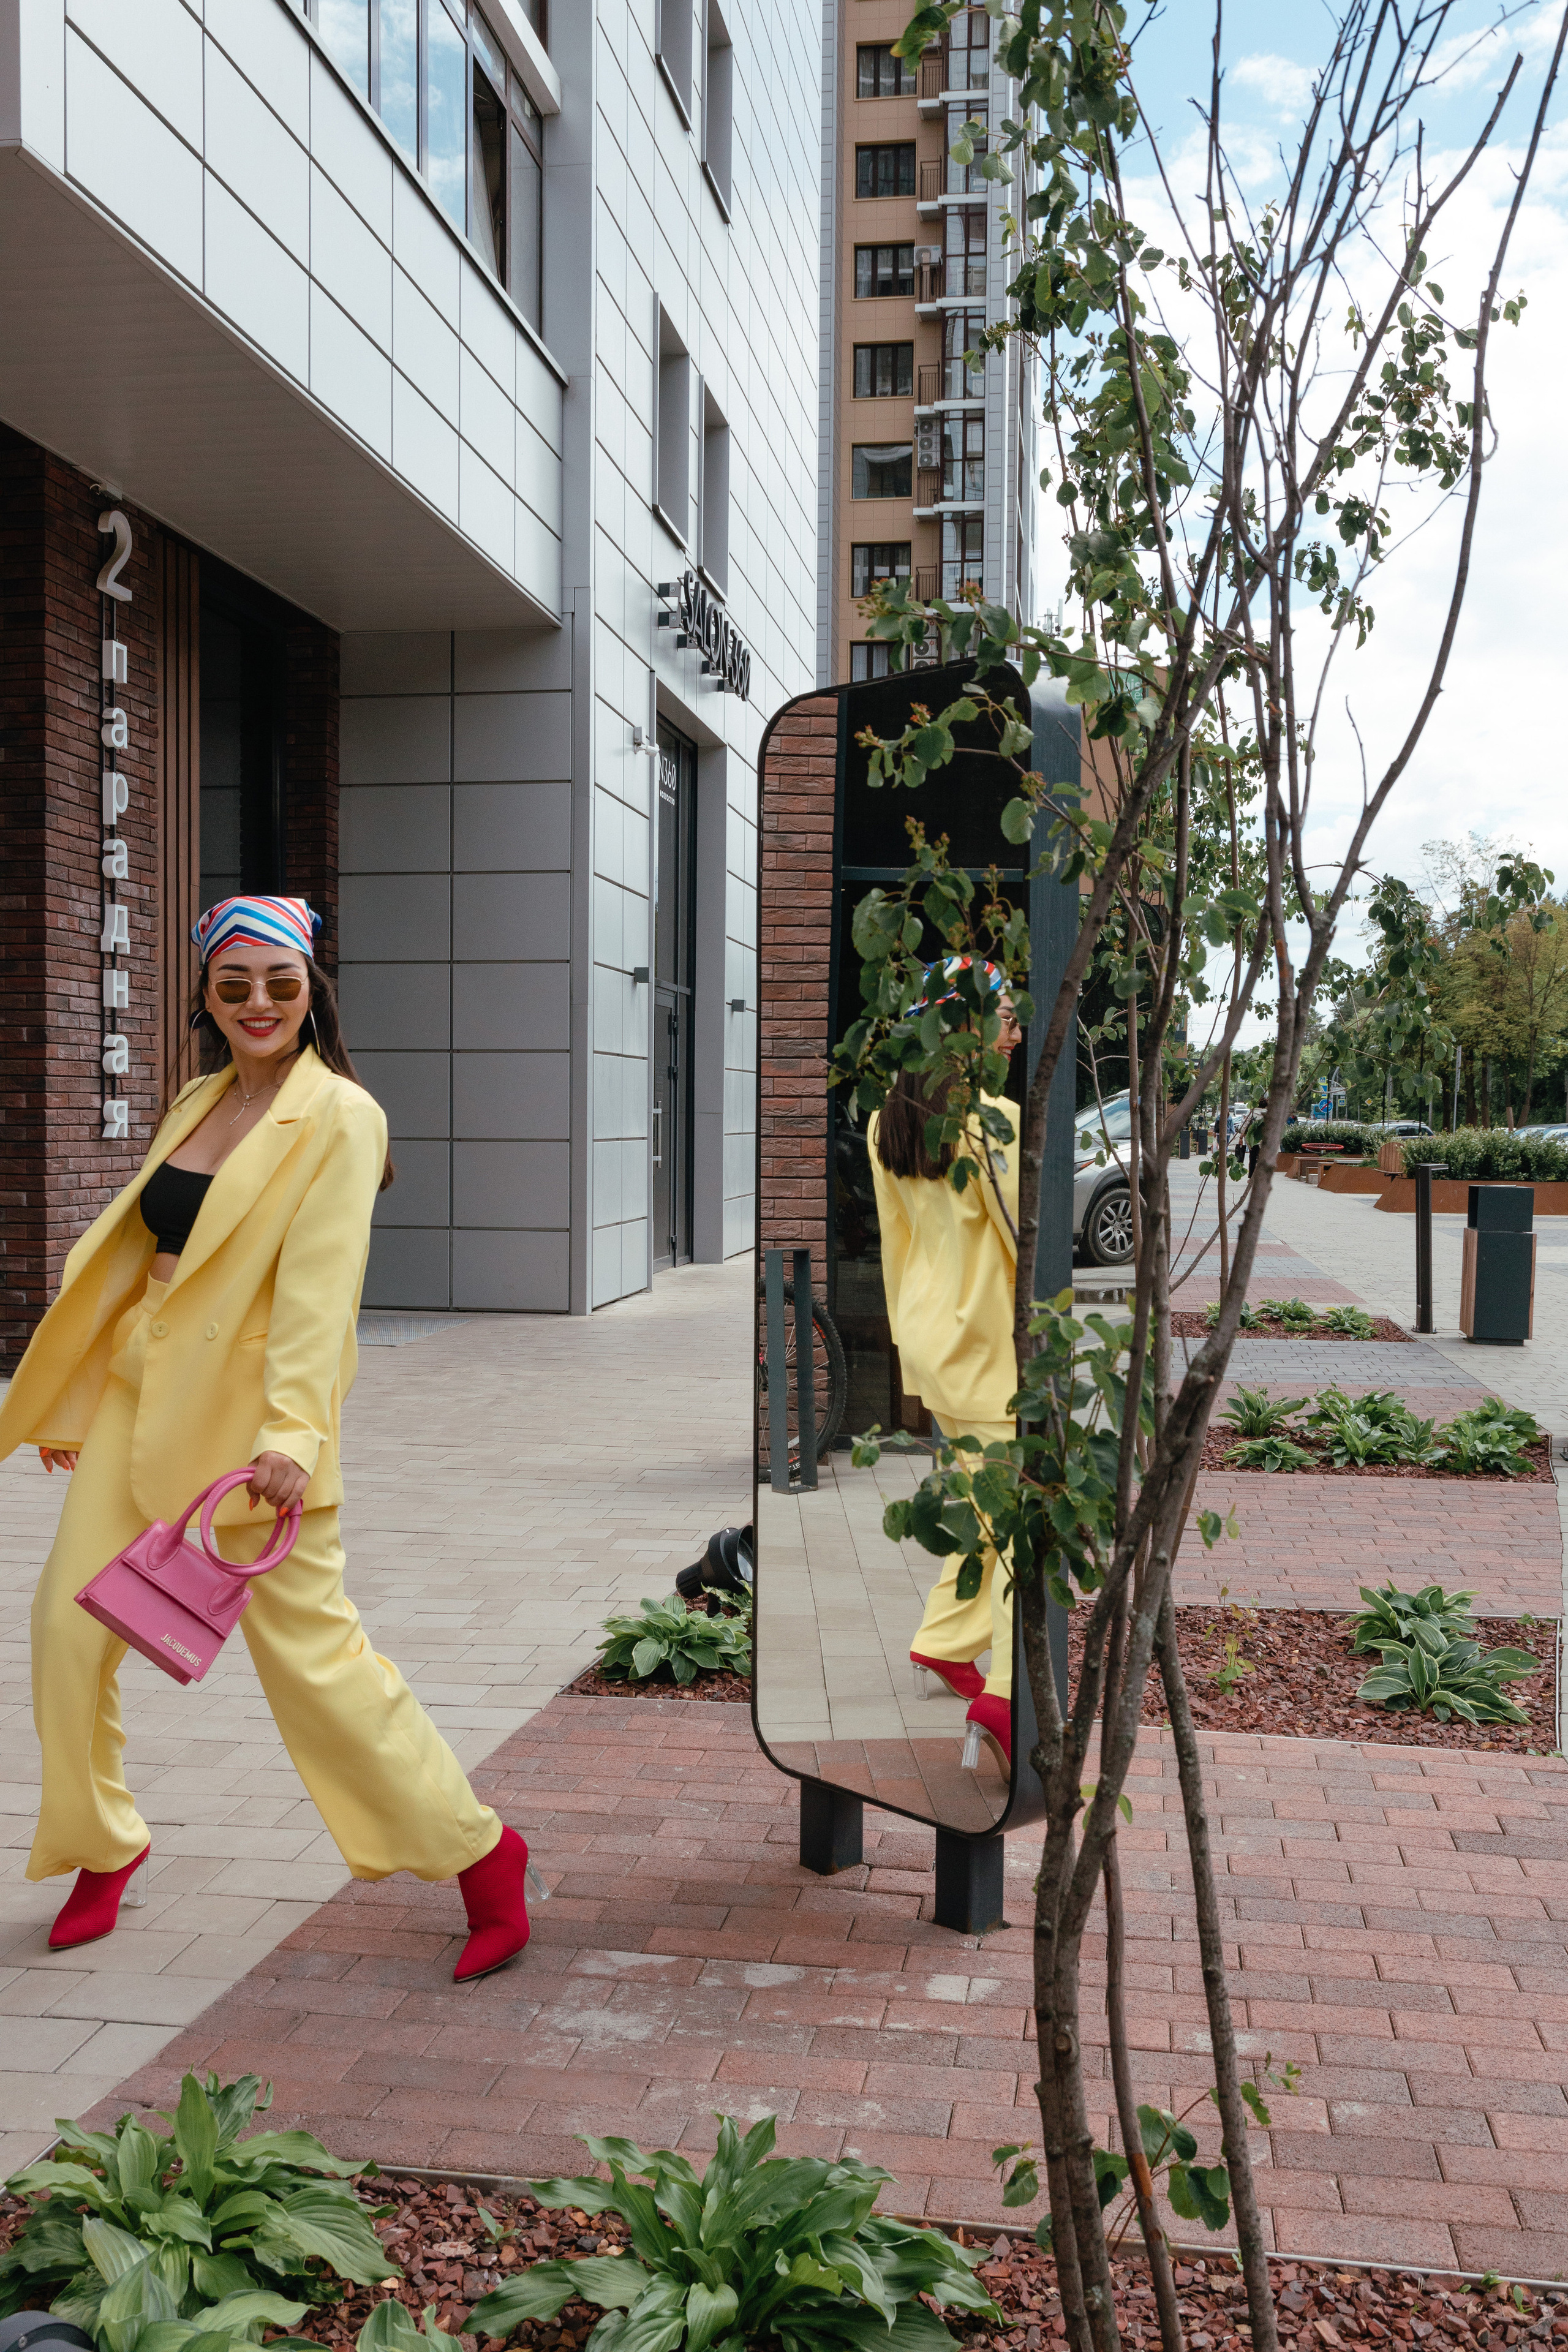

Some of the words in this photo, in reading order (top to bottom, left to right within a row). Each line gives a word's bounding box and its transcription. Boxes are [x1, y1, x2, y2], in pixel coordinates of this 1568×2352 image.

[97, 510, 132, 601] 2
[101, 639, 130, 1138] парадная
[160, 1634, 202, 1667] JACQUEMUS
